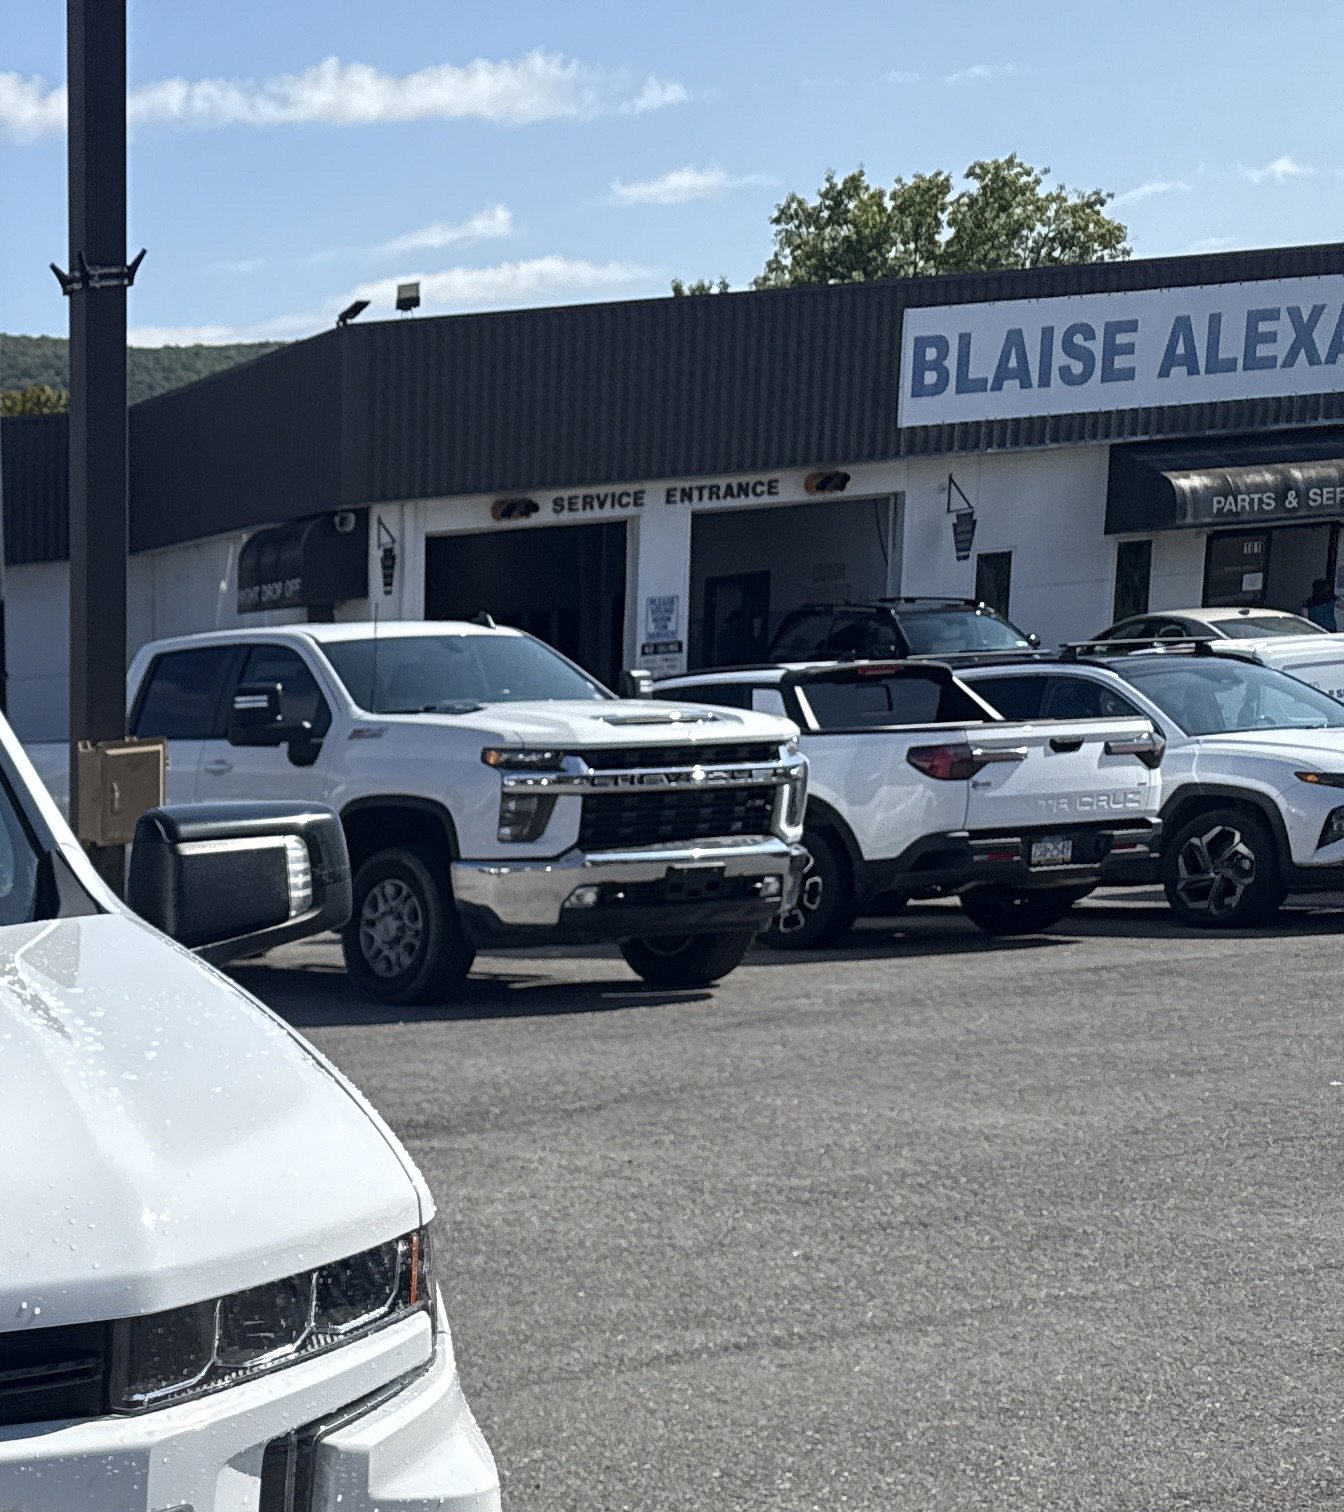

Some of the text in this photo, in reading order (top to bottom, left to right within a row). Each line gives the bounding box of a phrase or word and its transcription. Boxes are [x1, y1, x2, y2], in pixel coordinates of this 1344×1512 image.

[910, 318, 1139, 399] BLAISE
[551, 479, 780, 514] SERVICE ENTRANCE
[1212, 491, 1277, 514] PARTS
[1284, 489, 1299, 509] &
